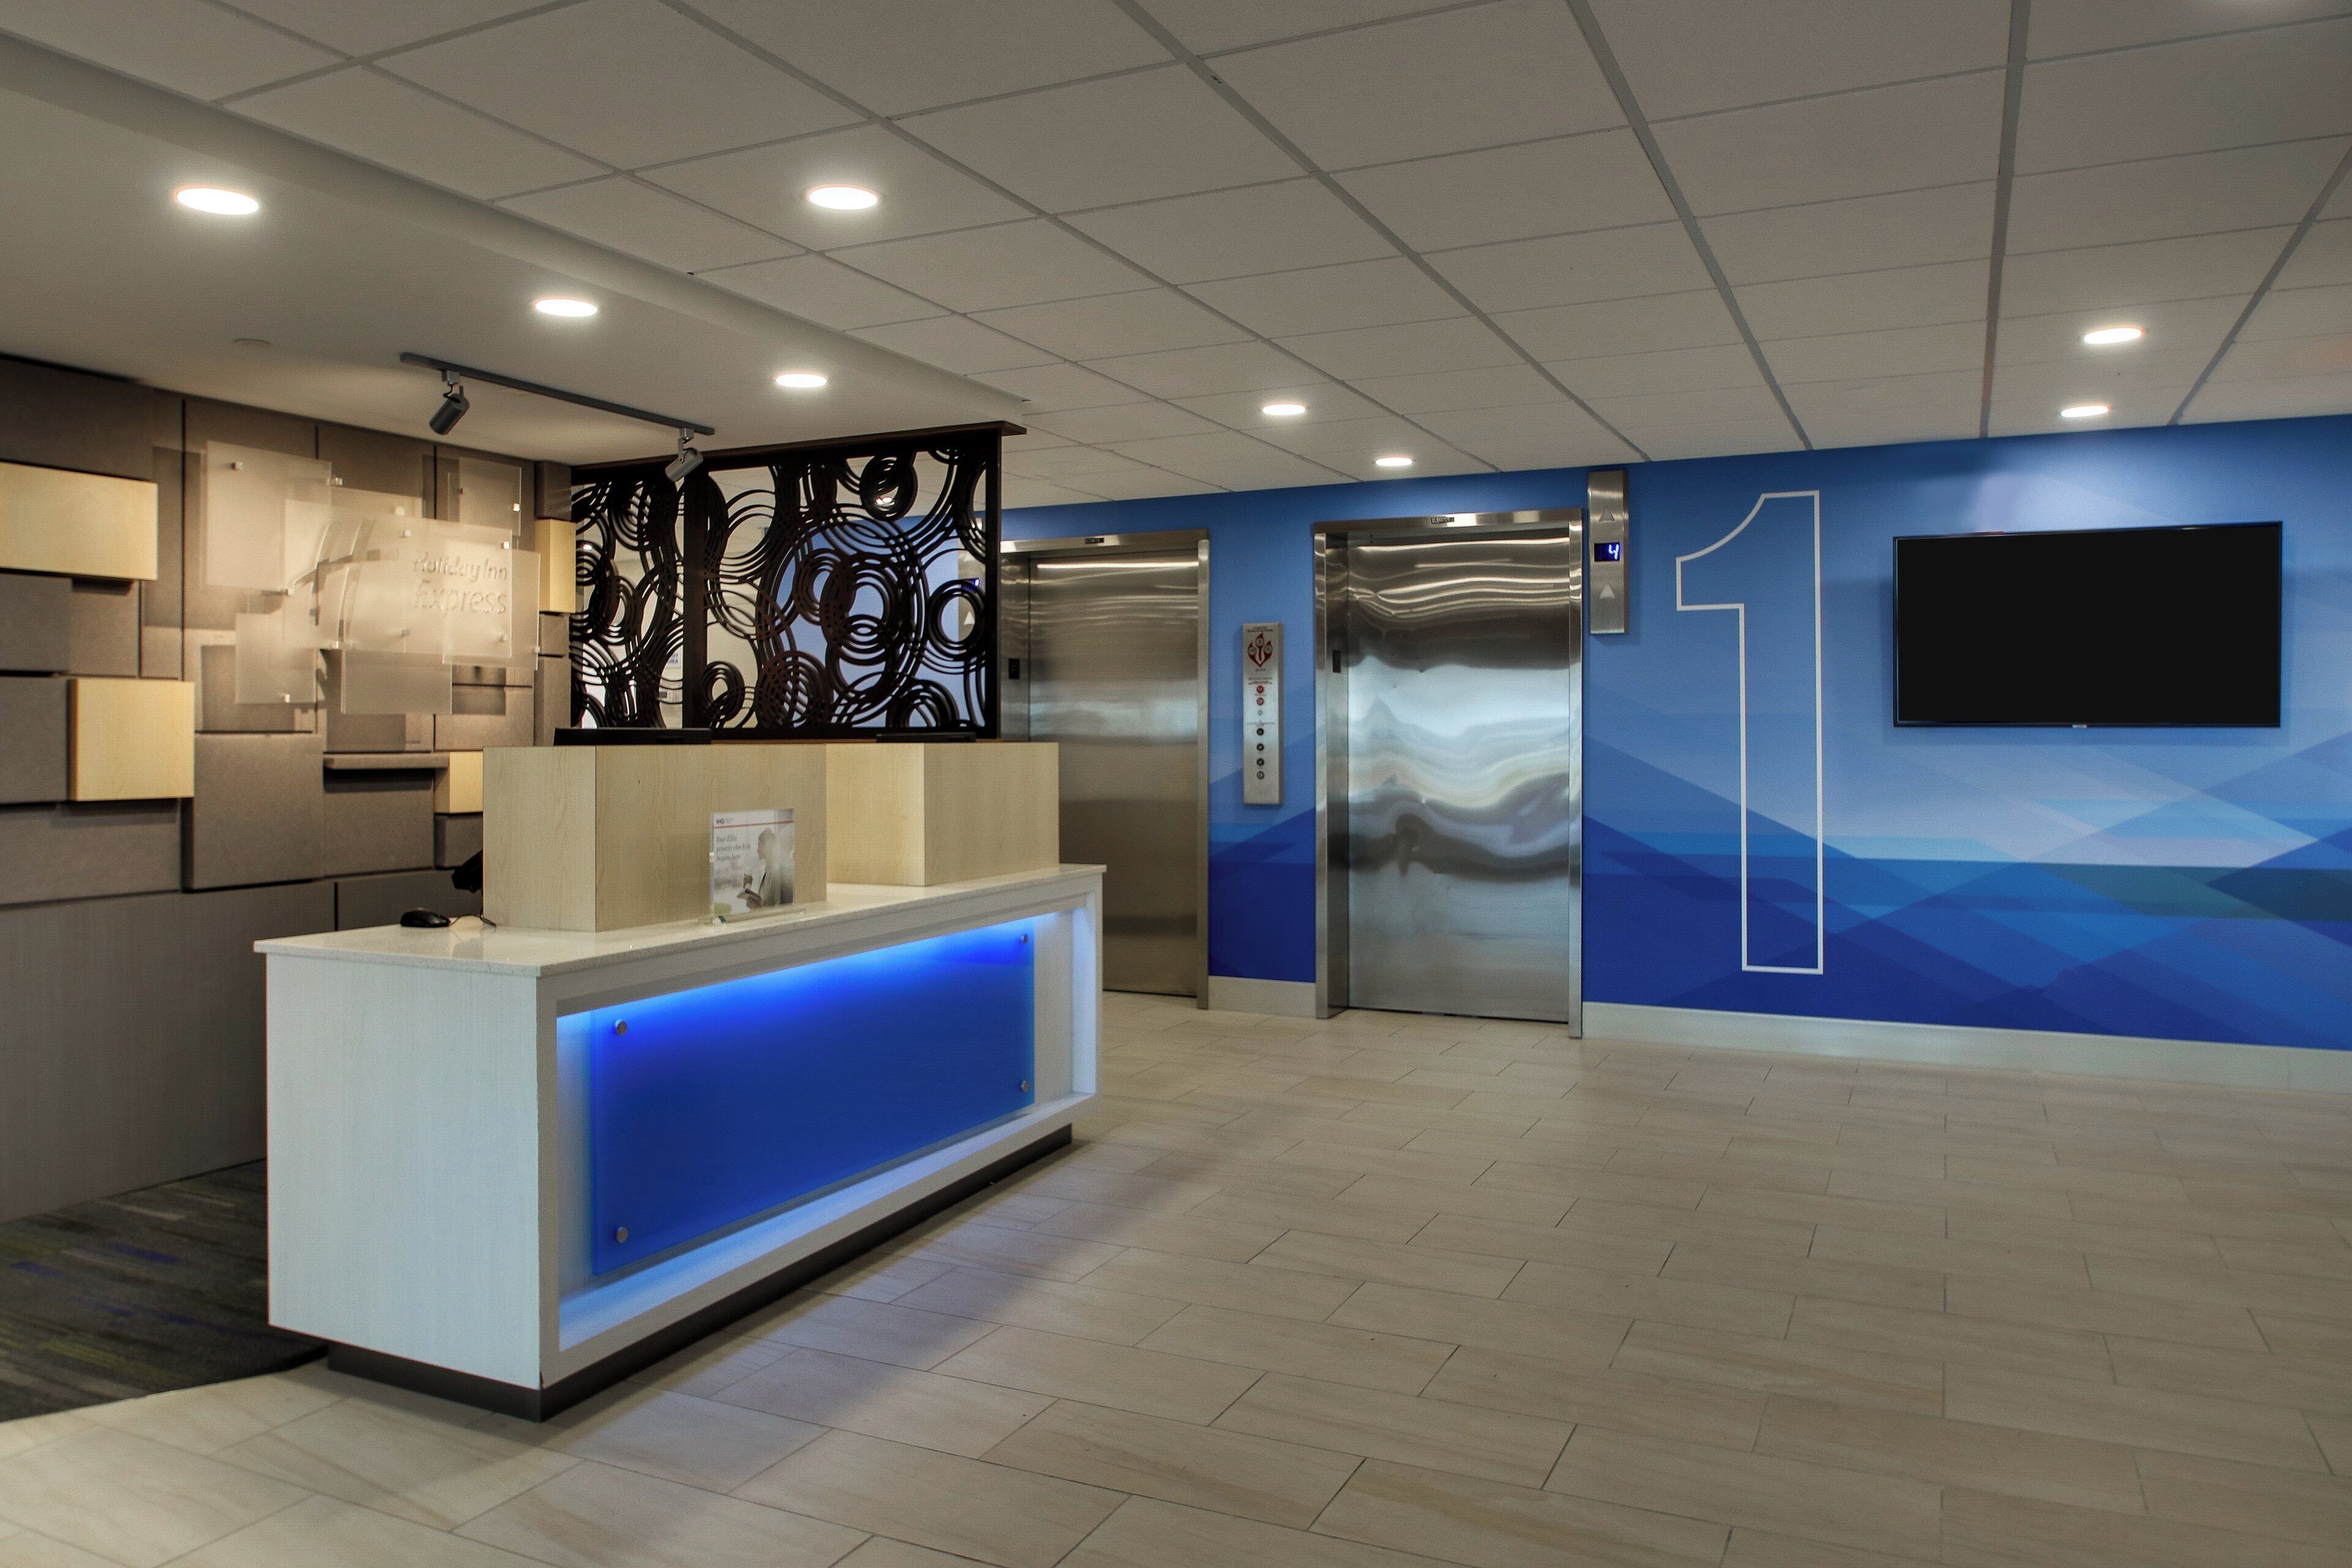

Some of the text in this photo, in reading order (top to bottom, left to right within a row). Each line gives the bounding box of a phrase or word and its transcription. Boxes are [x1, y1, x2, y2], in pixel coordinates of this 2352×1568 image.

[1608, 544, 1619, 560] 4
[483, 558, 507, 579] Inn
[414, 580, 507, 617] Express
[1676, 490, 1823, 975] 1
